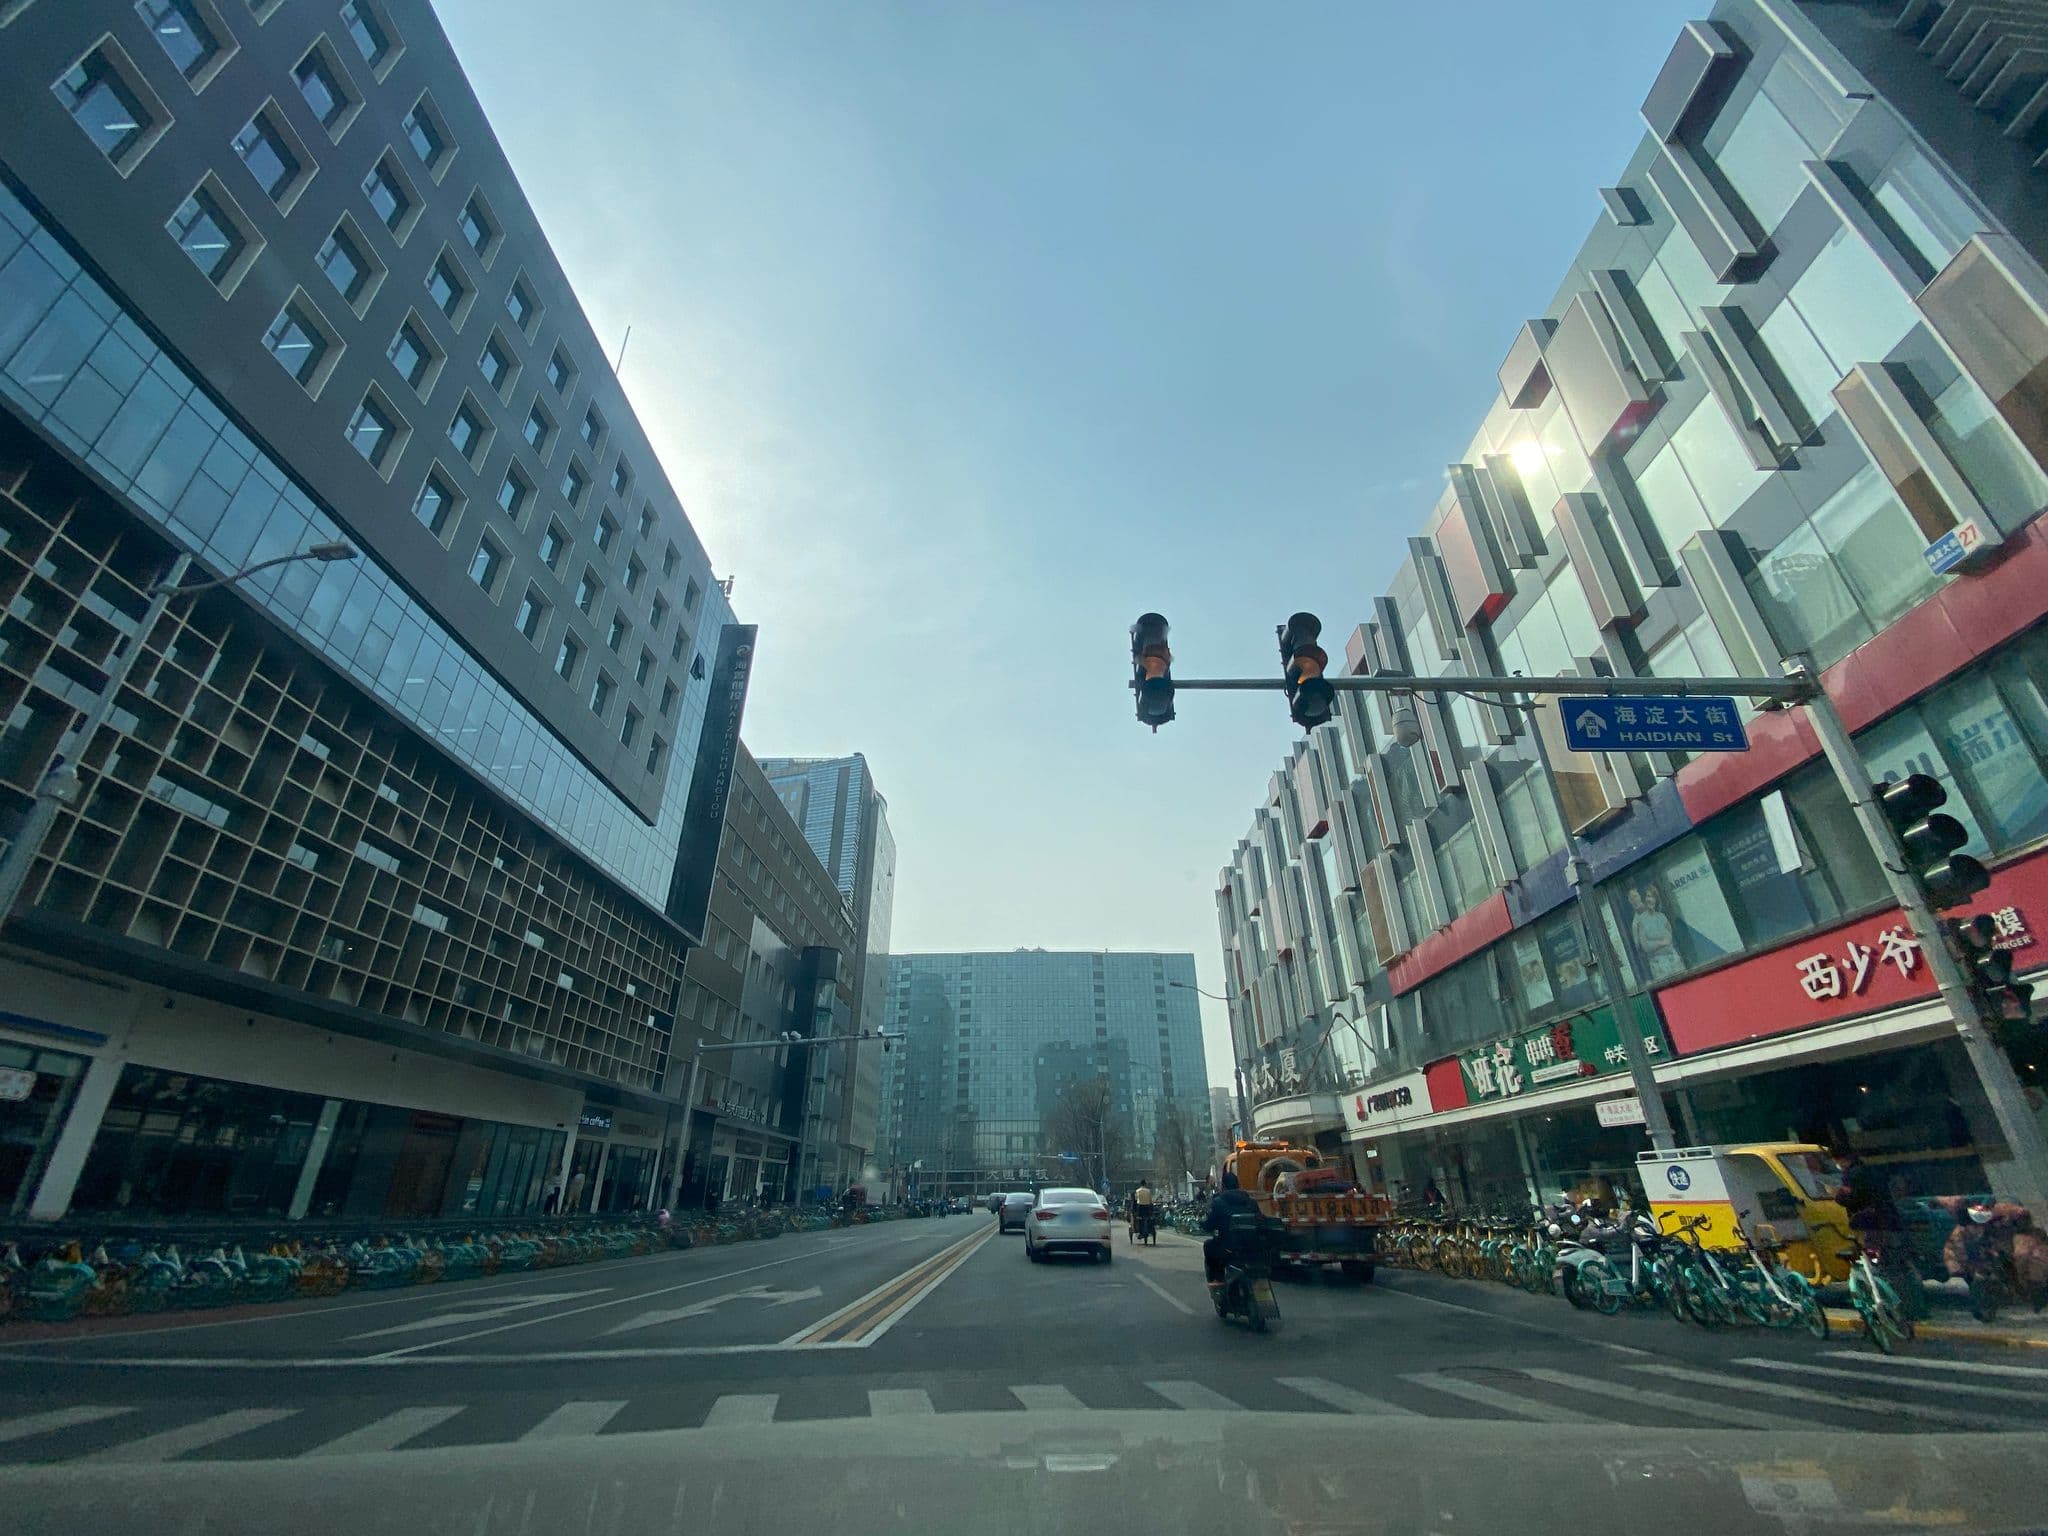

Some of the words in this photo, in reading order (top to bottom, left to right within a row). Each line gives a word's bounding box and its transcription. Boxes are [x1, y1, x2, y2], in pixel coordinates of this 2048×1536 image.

[1958, 524, 1976, 547] 27
[1614, 706, 1728, 726] 海淀大街
[1620, 732, 1701, 742] HAIDIAN
[1713, 732, 1734, 743] St
[1796, 925, 1920, 1000] 西少爷
